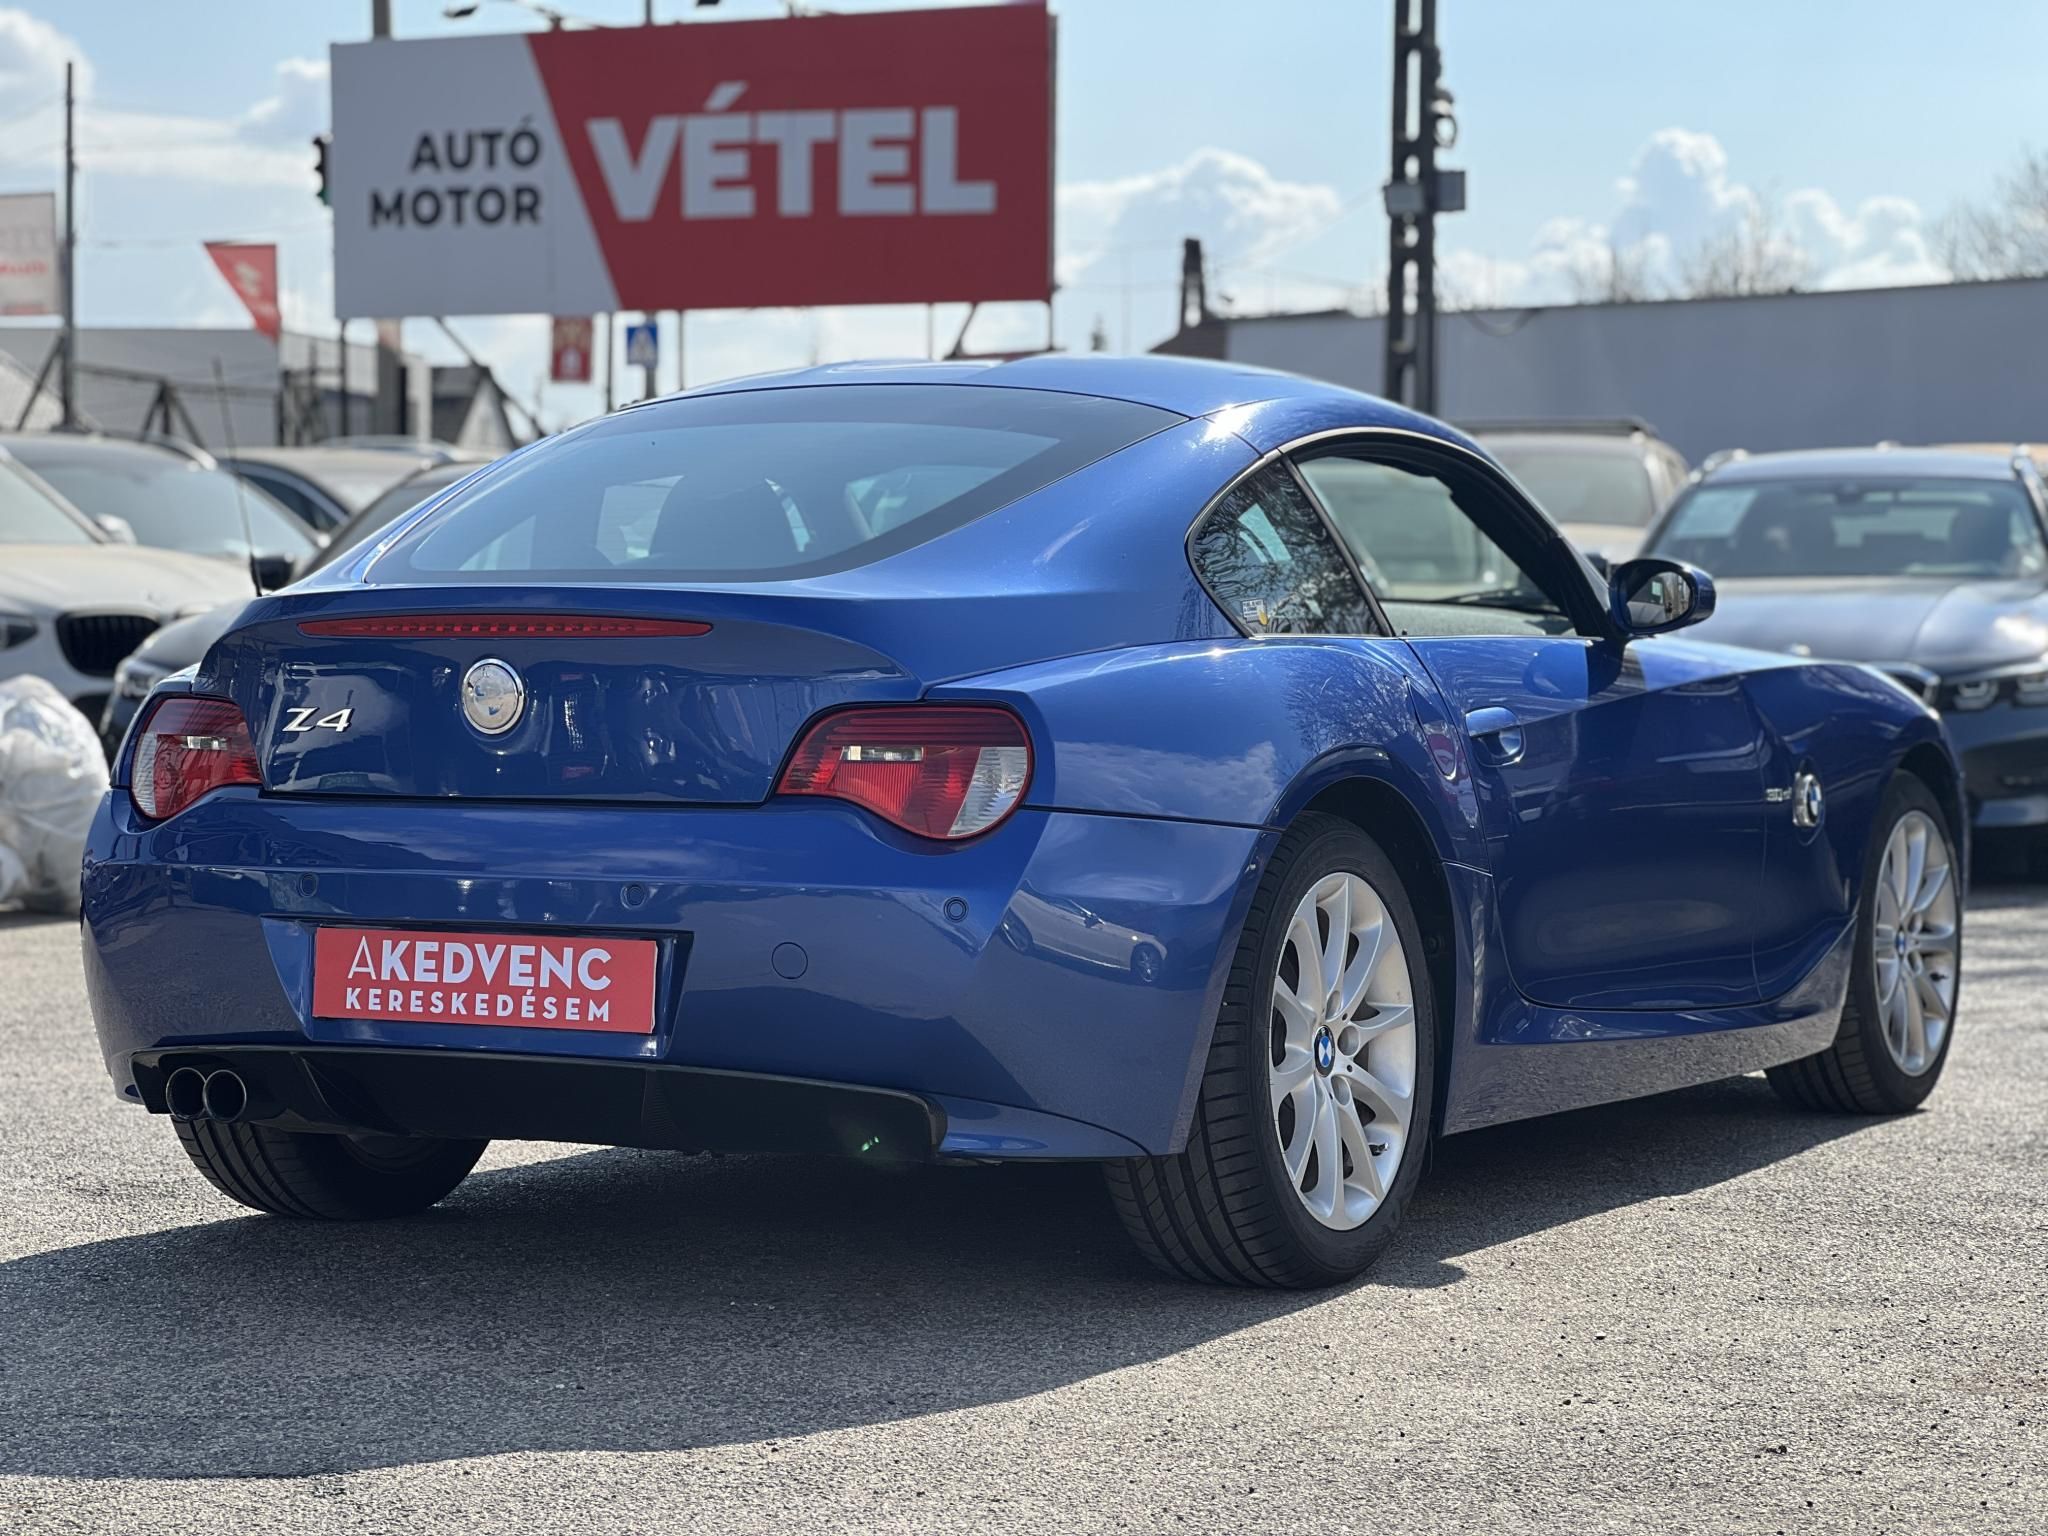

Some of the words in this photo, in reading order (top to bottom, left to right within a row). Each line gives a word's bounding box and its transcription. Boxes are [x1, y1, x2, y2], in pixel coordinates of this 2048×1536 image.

[409, 115, 541, 175] AUTÓ
[585, 80, 997, 221] VÉTEL
[370, 186, 541, 229] MOTOR
[282, 706, 353, 732] Z4
[345, 987, 609, 1023] KERESKEDÉSEM
